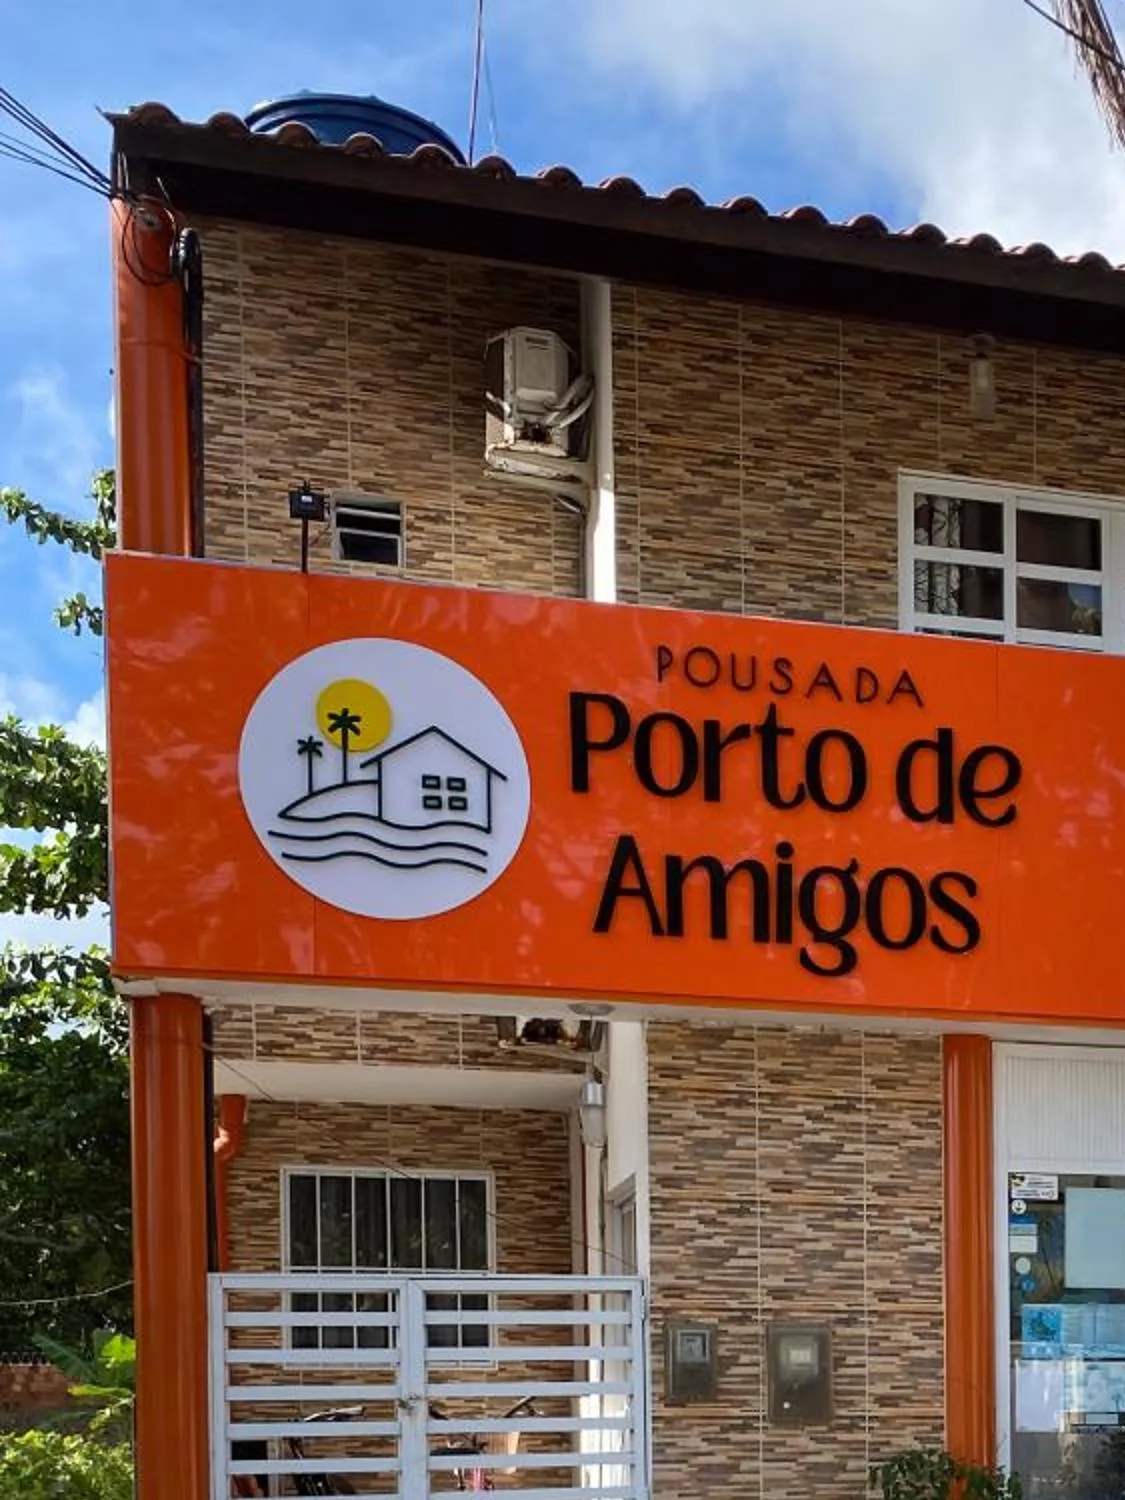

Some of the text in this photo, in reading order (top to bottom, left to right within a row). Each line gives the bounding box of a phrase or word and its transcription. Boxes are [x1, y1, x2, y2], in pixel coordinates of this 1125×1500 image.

[656, 643, 925, 708] POUSADA
[568, 690, 1023, 828] Porto de
[591, 833, 981, 978] Amigos
